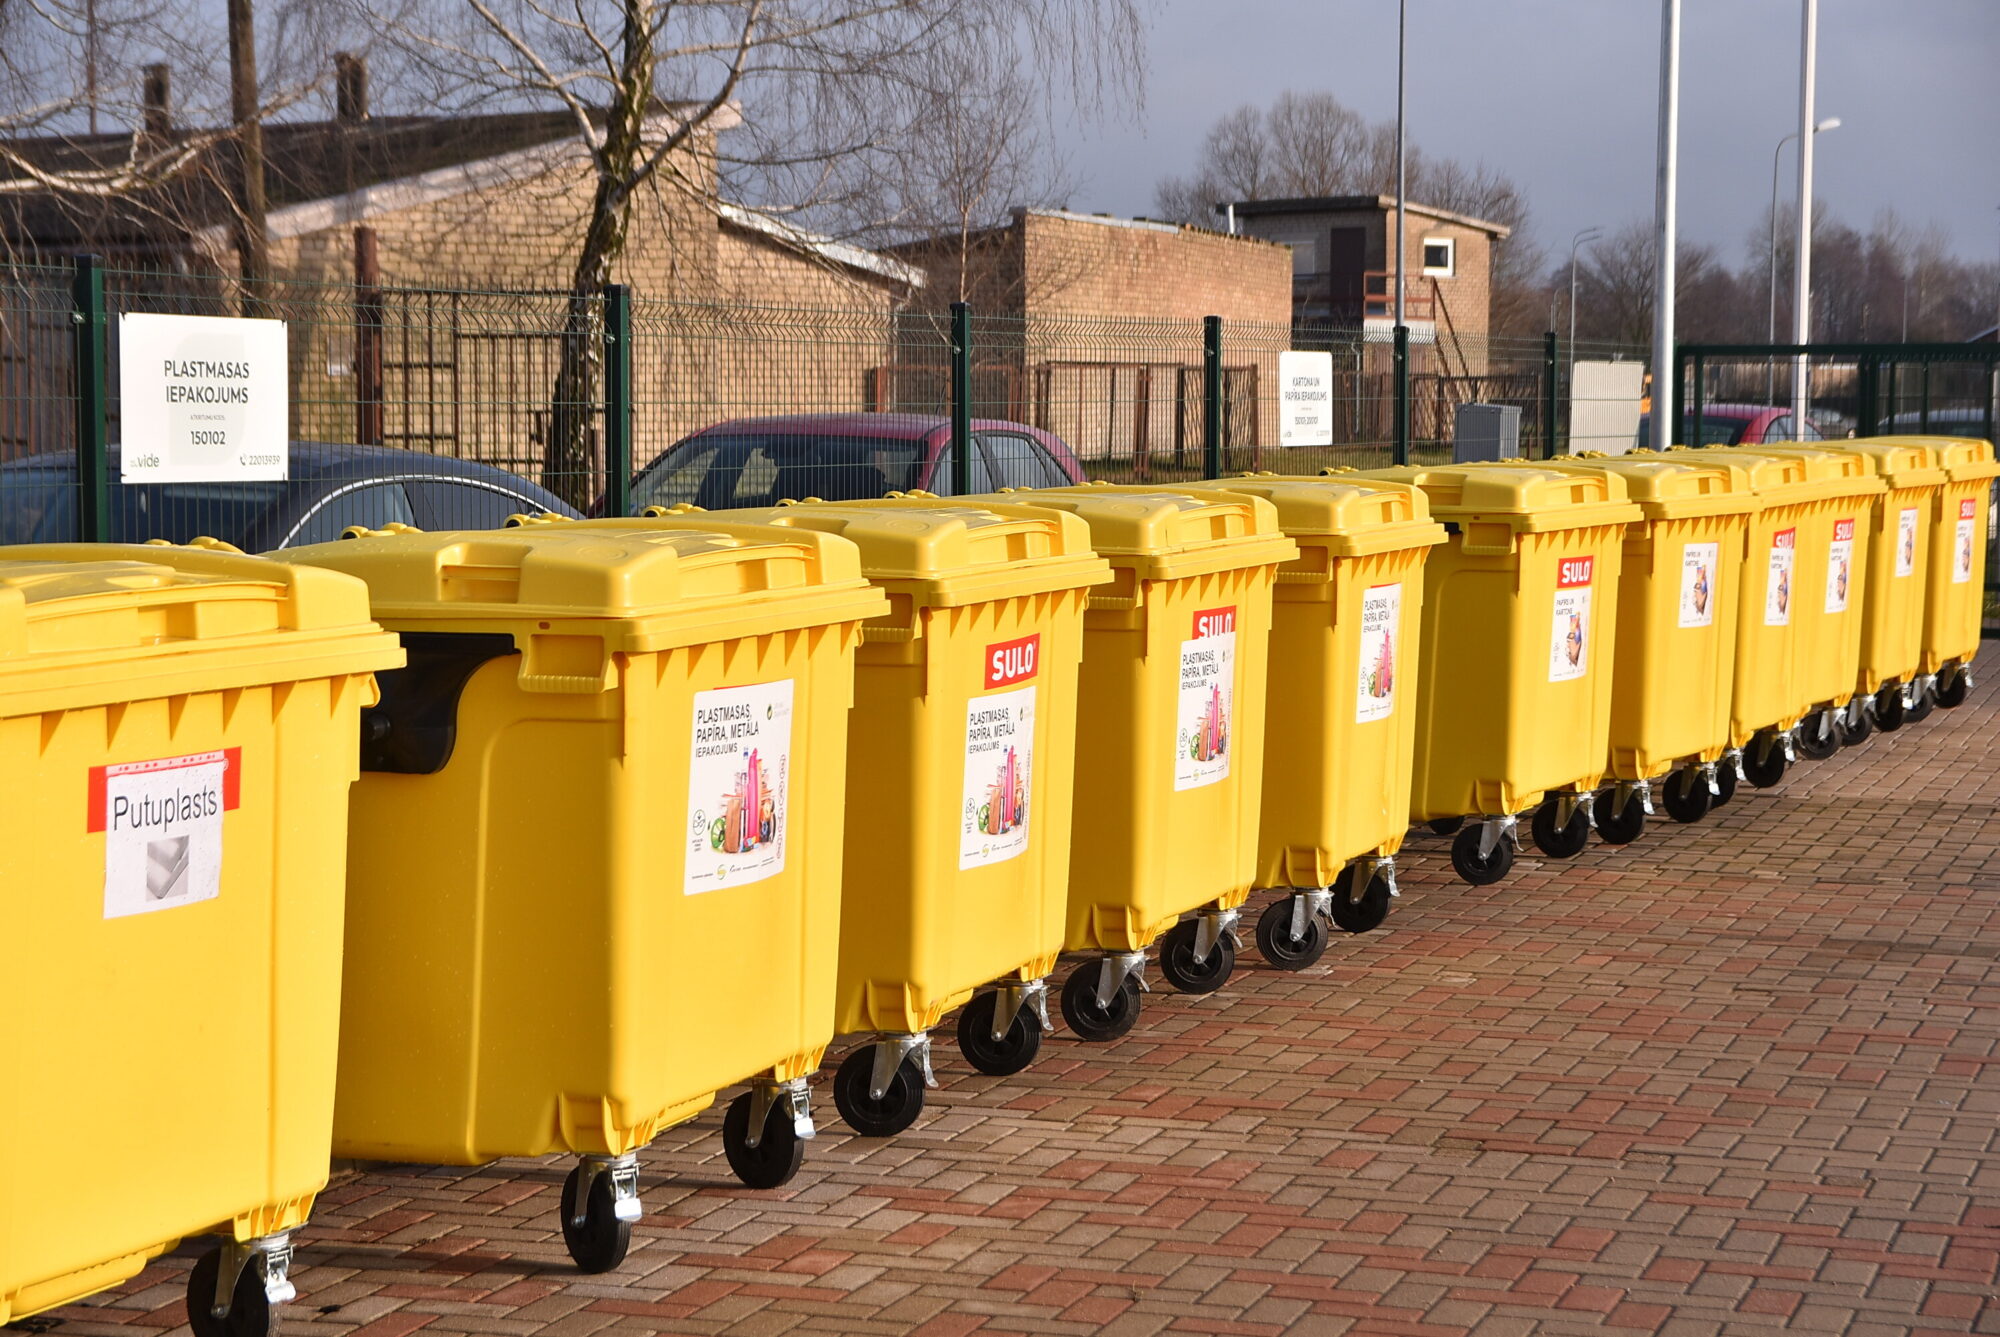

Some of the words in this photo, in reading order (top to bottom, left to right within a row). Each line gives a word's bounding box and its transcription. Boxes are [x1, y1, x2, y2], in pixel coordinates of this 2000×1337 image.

[164, 360, 250, 379] PLASTMASAS
[1292, 376, 1313, 387] KARTONA
[165, 386, 249, 404] IEPAKOJUMS
[1301, 391, 1327, 401] IEPAKOJUMS
[190, 430, 226, 446] 150102
[249, 455, 281, 466] 22013939
[1561, 560, 1590, 584] SULO
[991, 642, 1034, 681] SULO
[697, 703, 752, 724] PLASTMASAS,
[969, 707, 1011, 726] PLASTMASAS,
[696, 723, 728, 743] PAPĪRA,
[730, 719, 759, 739] METĀLA
[968, 725, 992, 742] PAPĪRA,
[994, 720, 1015, 738] METĀLA
[695, 742, 738, 758] IEPAKOJUMS
[968, 740, 1000, 754] IEPAKOJUMS
[113, 784, 218, 833] Putuplasts
